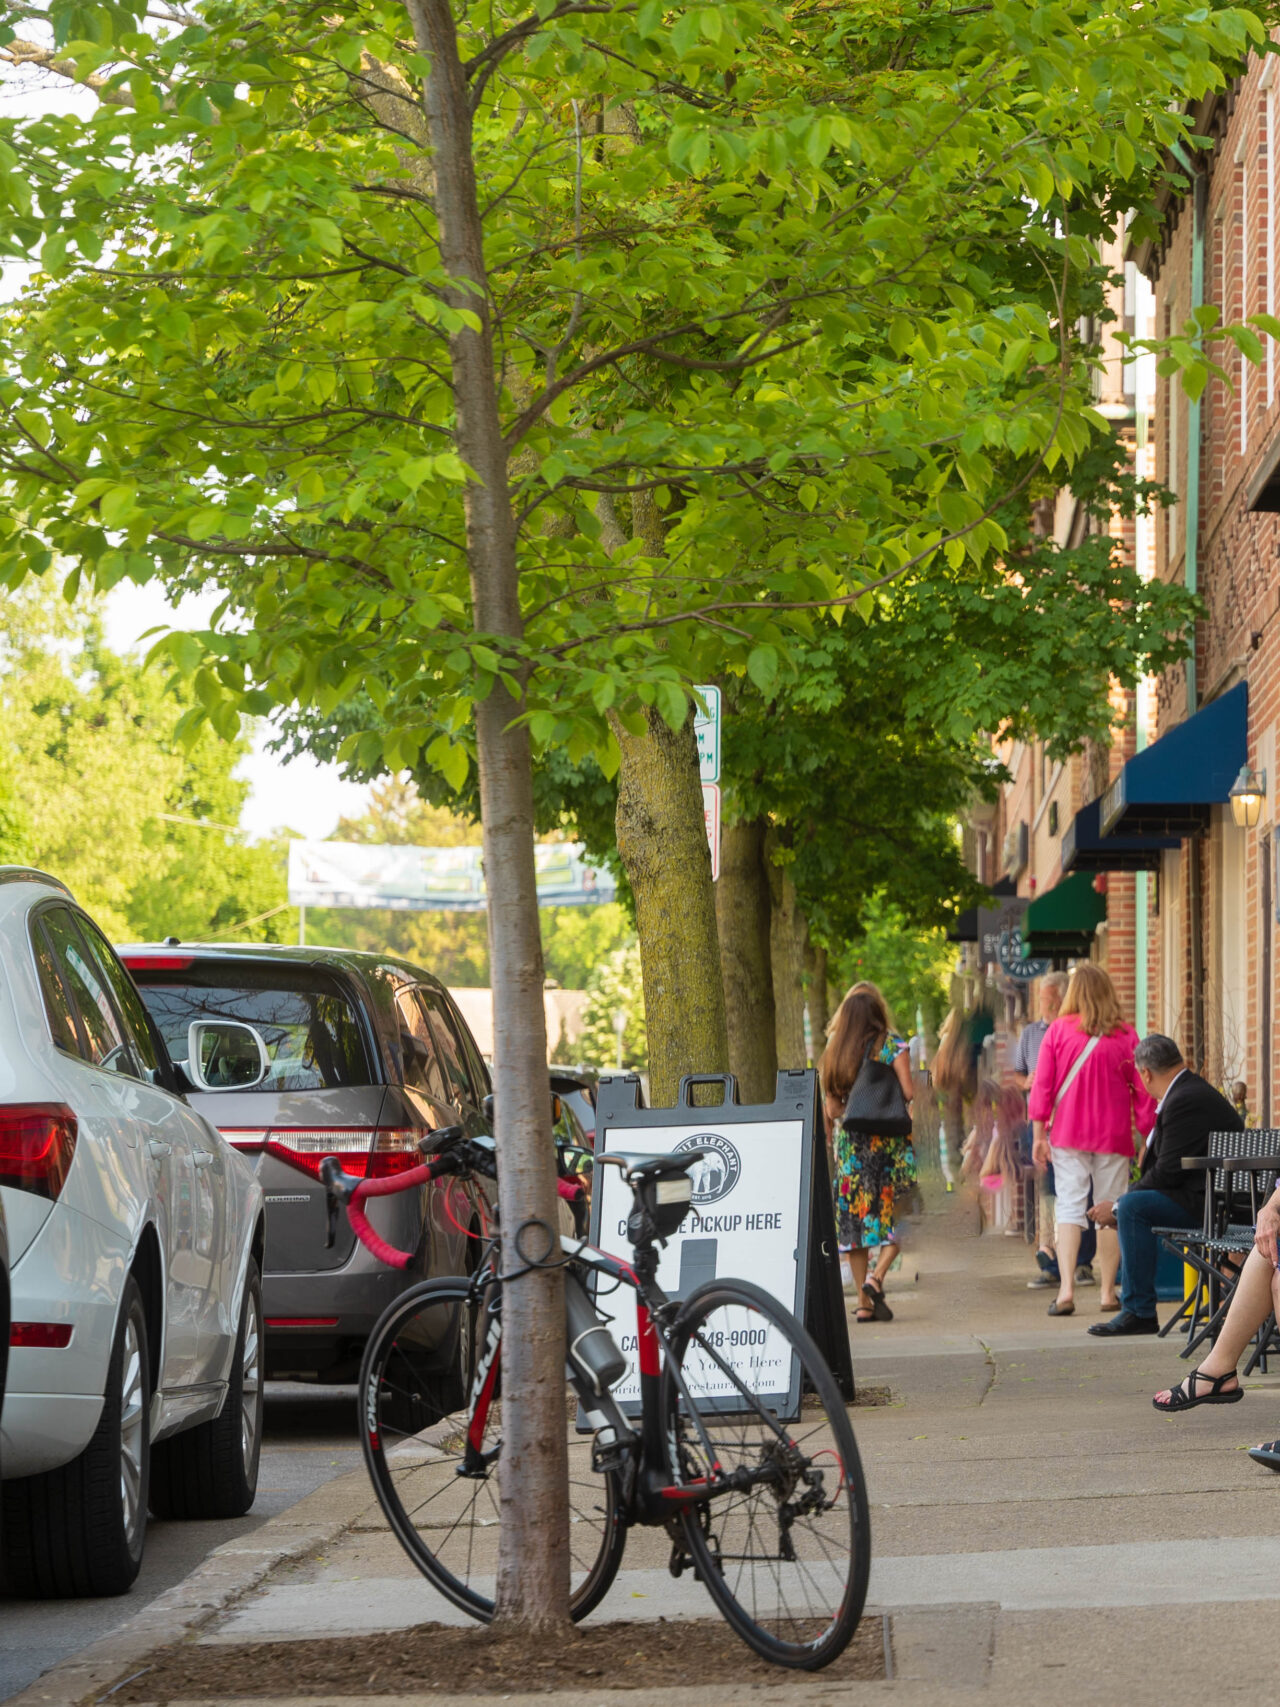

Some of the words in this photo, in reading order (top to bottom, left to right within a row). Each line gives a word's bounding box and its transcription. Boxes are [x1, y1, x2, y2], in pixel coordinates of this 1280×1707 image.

[696, 1137, 737, 1172] ELEPHANT
[691, 1215, 742, 1234] PICKUP
[745, 1213, 782, 1231] HERE
[750, 1356, 782, 1368] Here
